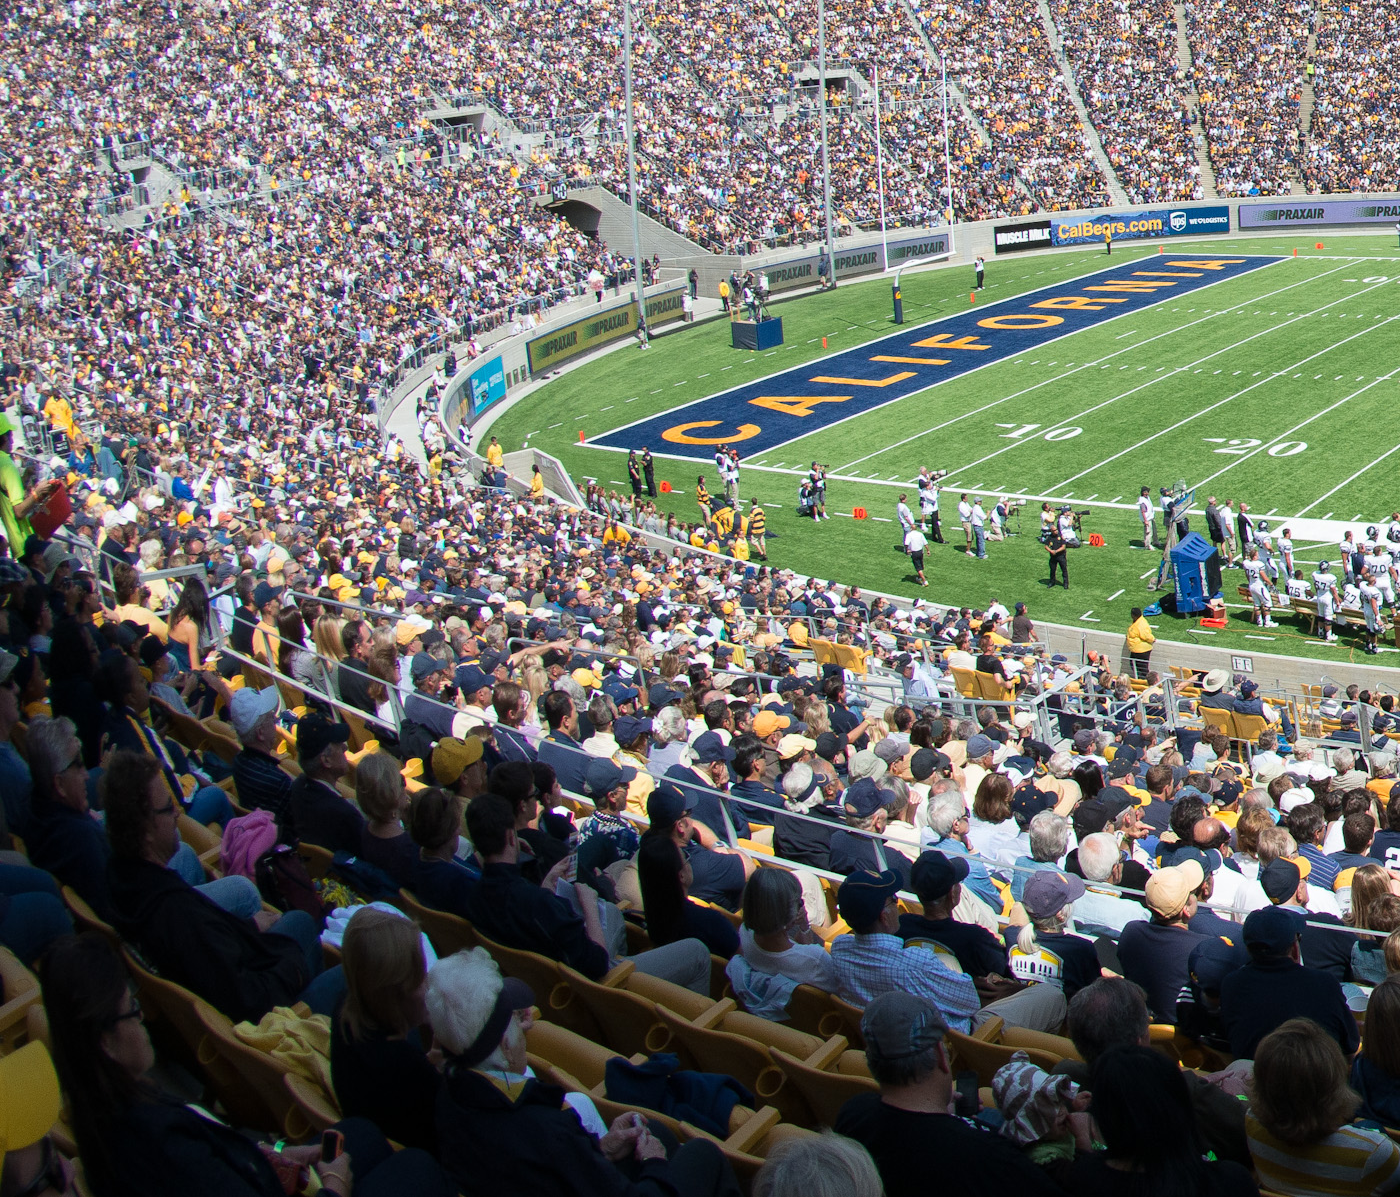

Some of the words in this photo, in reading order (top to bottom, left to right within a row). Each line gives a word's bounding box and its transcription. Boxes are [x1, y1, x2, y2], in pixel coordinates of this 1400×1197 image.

[552, 183, 567, 199] 40
[1202, 216, 1228, 224] LOGISTICS
[1278, 208, 1324, 220] PRAXAIR
[996, 229, 1029, 246] MUSCLE
[1029, 228, 1050, 243] MILK
[906, 241, 944, 258] PRAXAIR
[839, 251, 878, 269] PRAXAIR
[776, 264, 812, 283] PRAXAIR
[599, 311, 630, 334] PRAXAIR
[550, 330, 578, 354] PRAXAIR
[661, 259, 1247, 446] CALIFORNIA
[999, 424, 1083, 440] 10
[1213, 439, 1308, 456] 20
[854, 508, 863, 518] 10
[1090, 535, 1100, 546] 20
[1371, 564, 1386, 574] 70
[1233, 658, 1250, 670] FF
